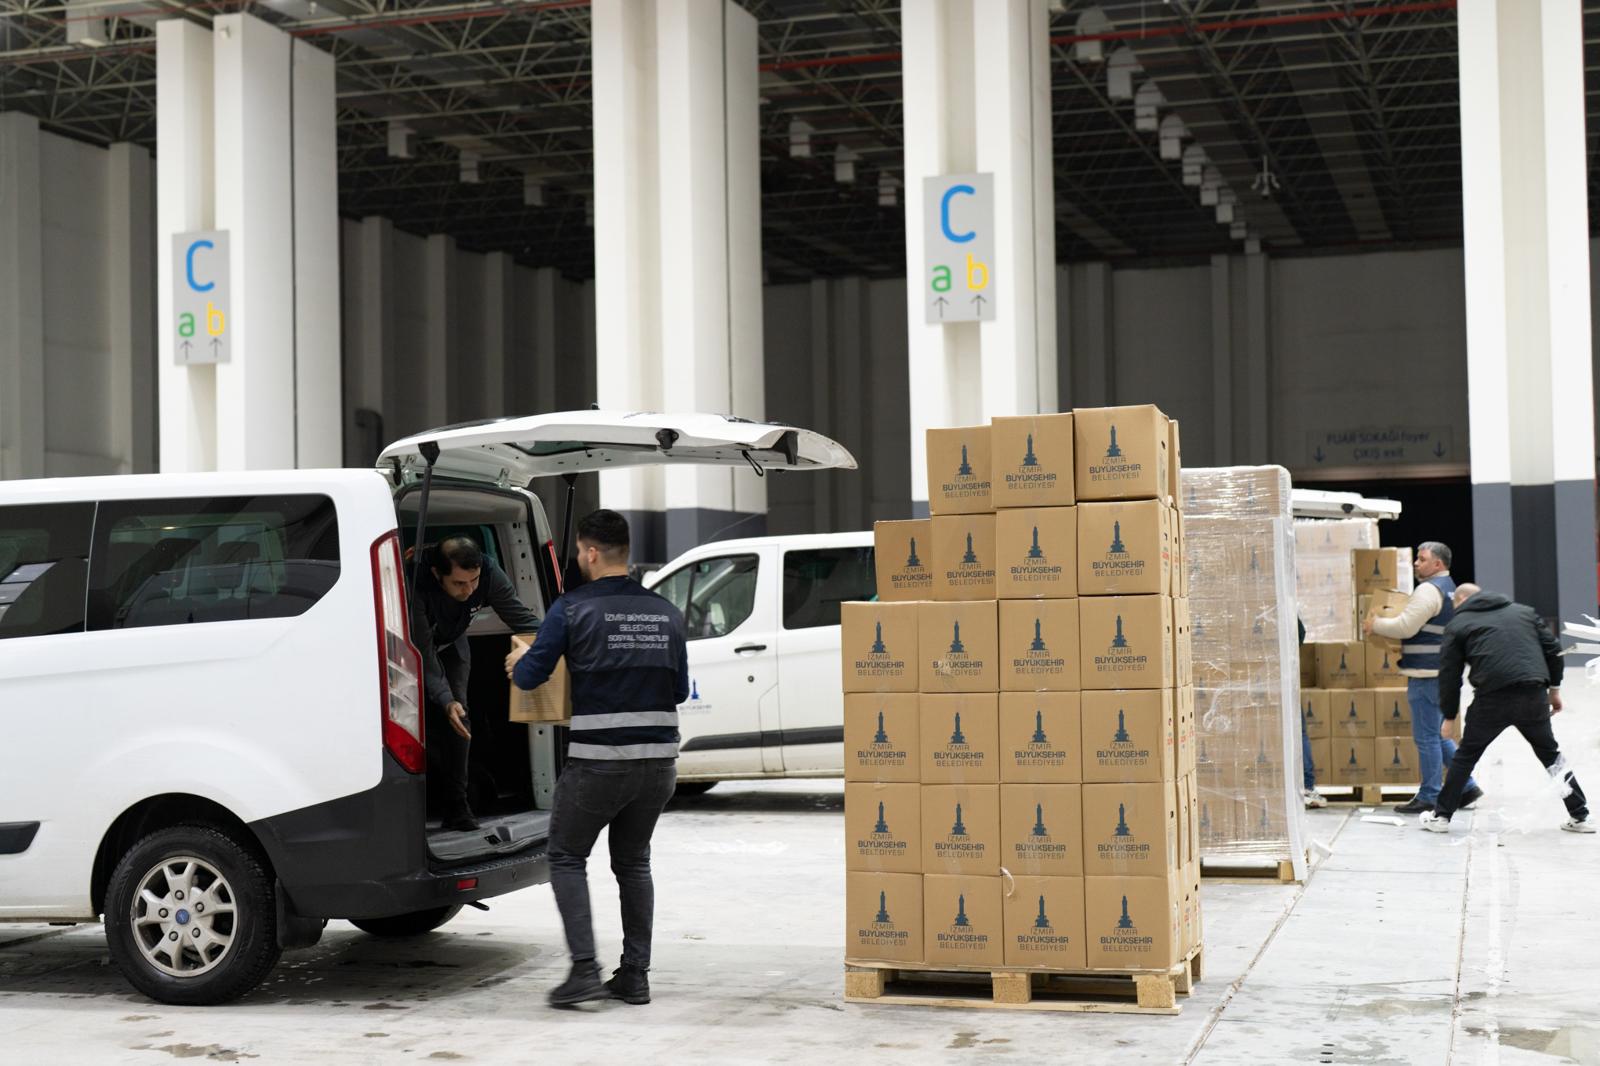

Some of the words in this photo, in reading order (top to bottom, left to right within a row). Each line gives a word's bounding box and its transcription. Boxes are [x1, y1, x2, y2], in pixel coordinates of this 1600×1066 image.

[940, 184, 976, 243] C
[186, 240, 215, 292] C
[931, 265, 952, 292] a
[966, 252, 989, 291] b
[178, 312, 195, 338] a
[207, 301, 225, 336] b
